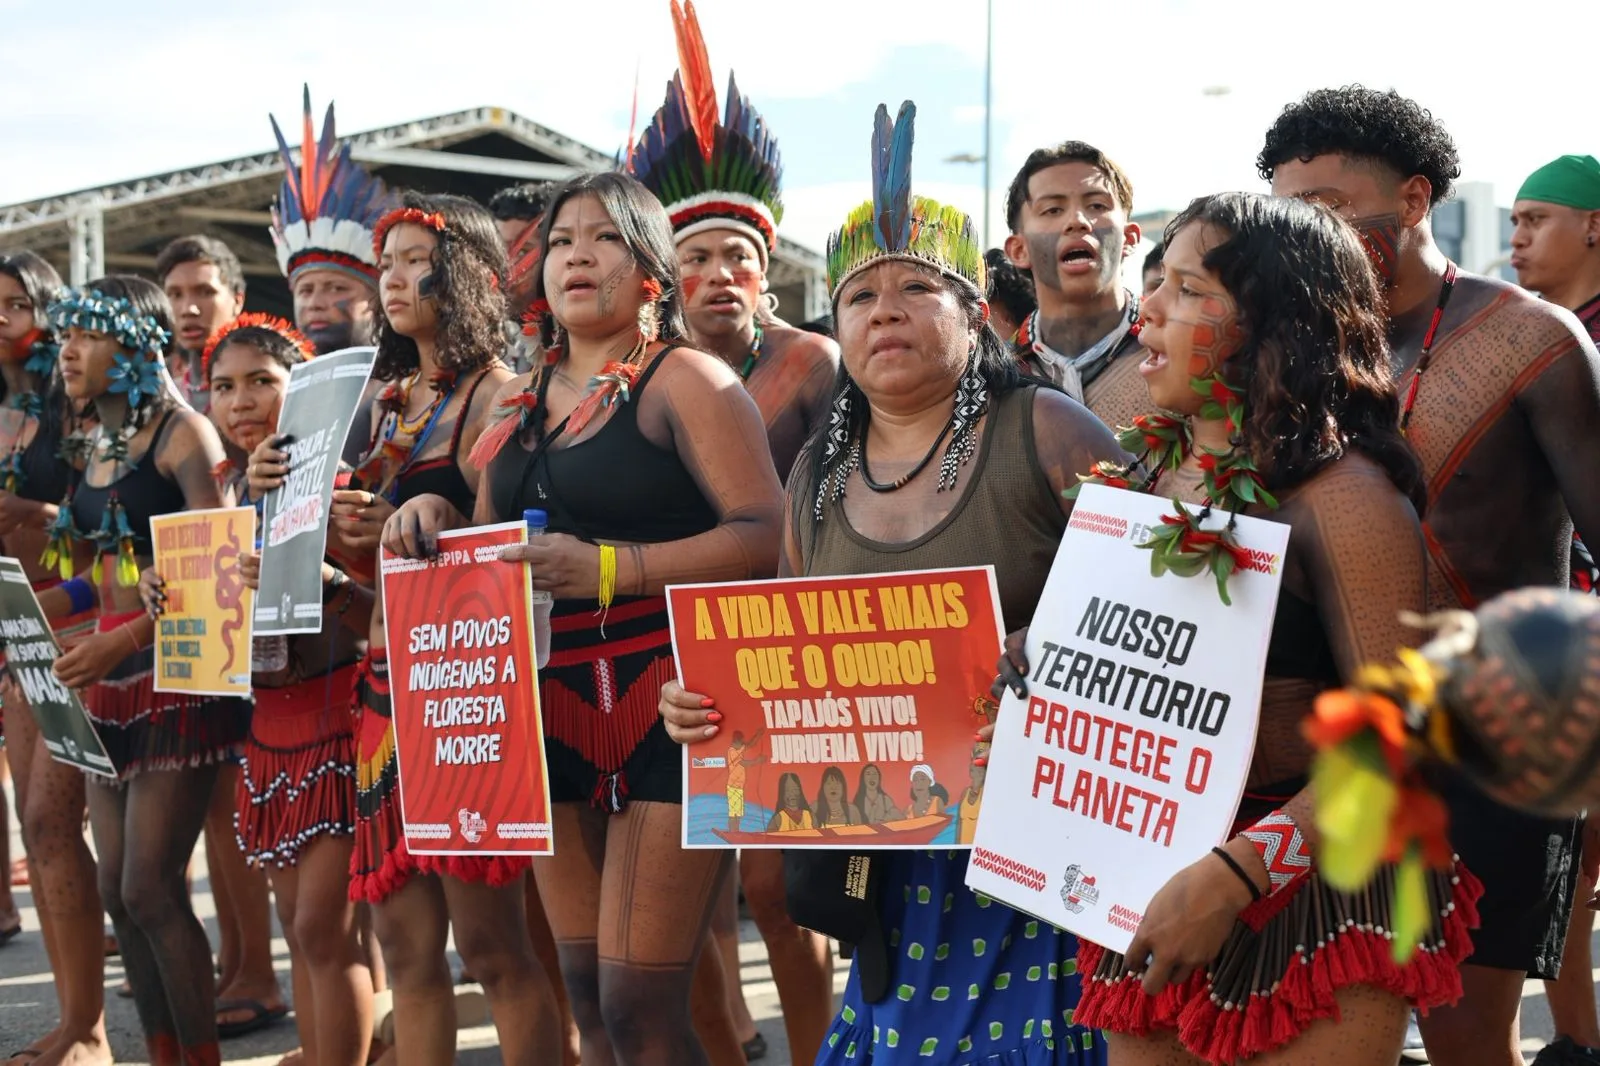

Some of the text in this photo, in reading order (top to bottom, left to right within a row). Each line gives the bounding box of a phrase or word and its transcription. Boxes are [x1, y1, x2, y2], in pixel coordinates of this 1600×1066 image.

[408, 615, 511, 654] SEM POVOS
[695, 582, 969, 641] A VIDA VALE MAIS
[1076, 596, 1198, 666] NOSSO
[408, 655, 517, 691] INDÍGENAS A
[735, 639, 937, 698] QUE O OURO!
[1032, 640, 1231, 737] TERRITÓRIO
[423, 695, 506, 728] FLORESTA
[761, 690, 917, 729] TAPAJÓS VIVO!
[435, 733, 501, 766] MORRE
[770, 730, 924, 764] JURUENA VIVO!
[1024, 695, 1213, 795] PROTEGE O
[1031, 755, 1179, 848] PLANETA
